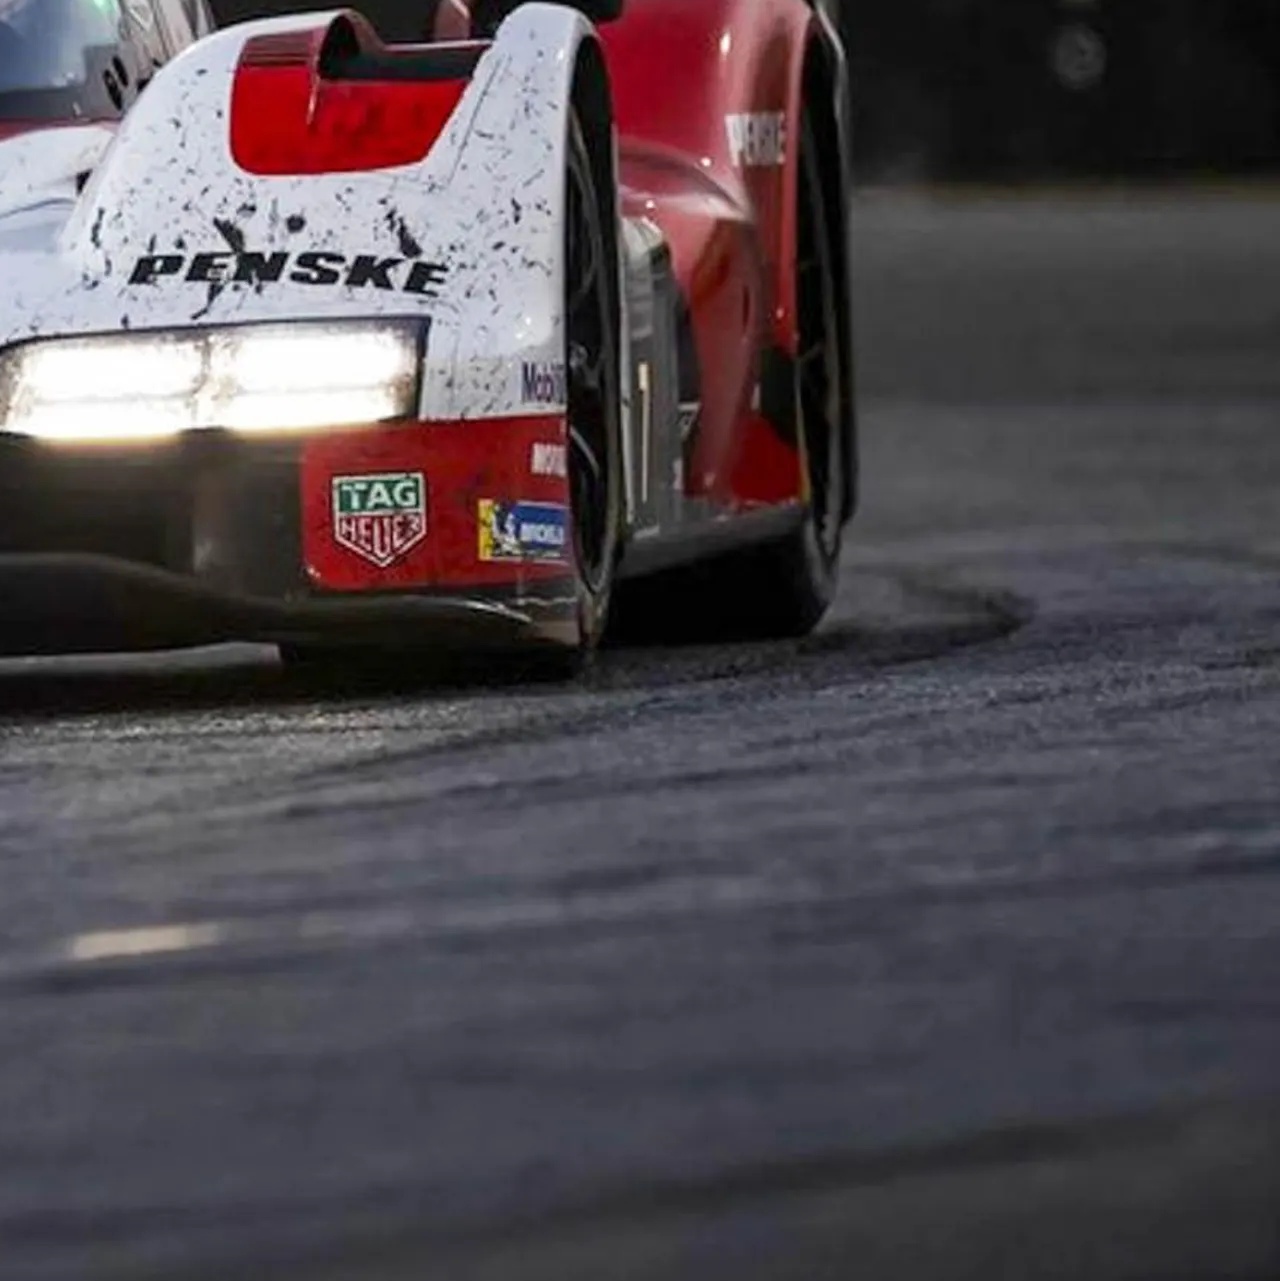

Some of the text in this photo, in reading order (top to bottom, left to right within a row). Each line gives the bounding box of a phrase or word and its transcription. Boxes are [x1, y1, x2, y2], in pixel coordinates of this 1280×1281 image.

[128, 252, 448, 298] PENSKE
[342, 481, 418, 510] TAG
[341, 516, 422, 558] HEUER
